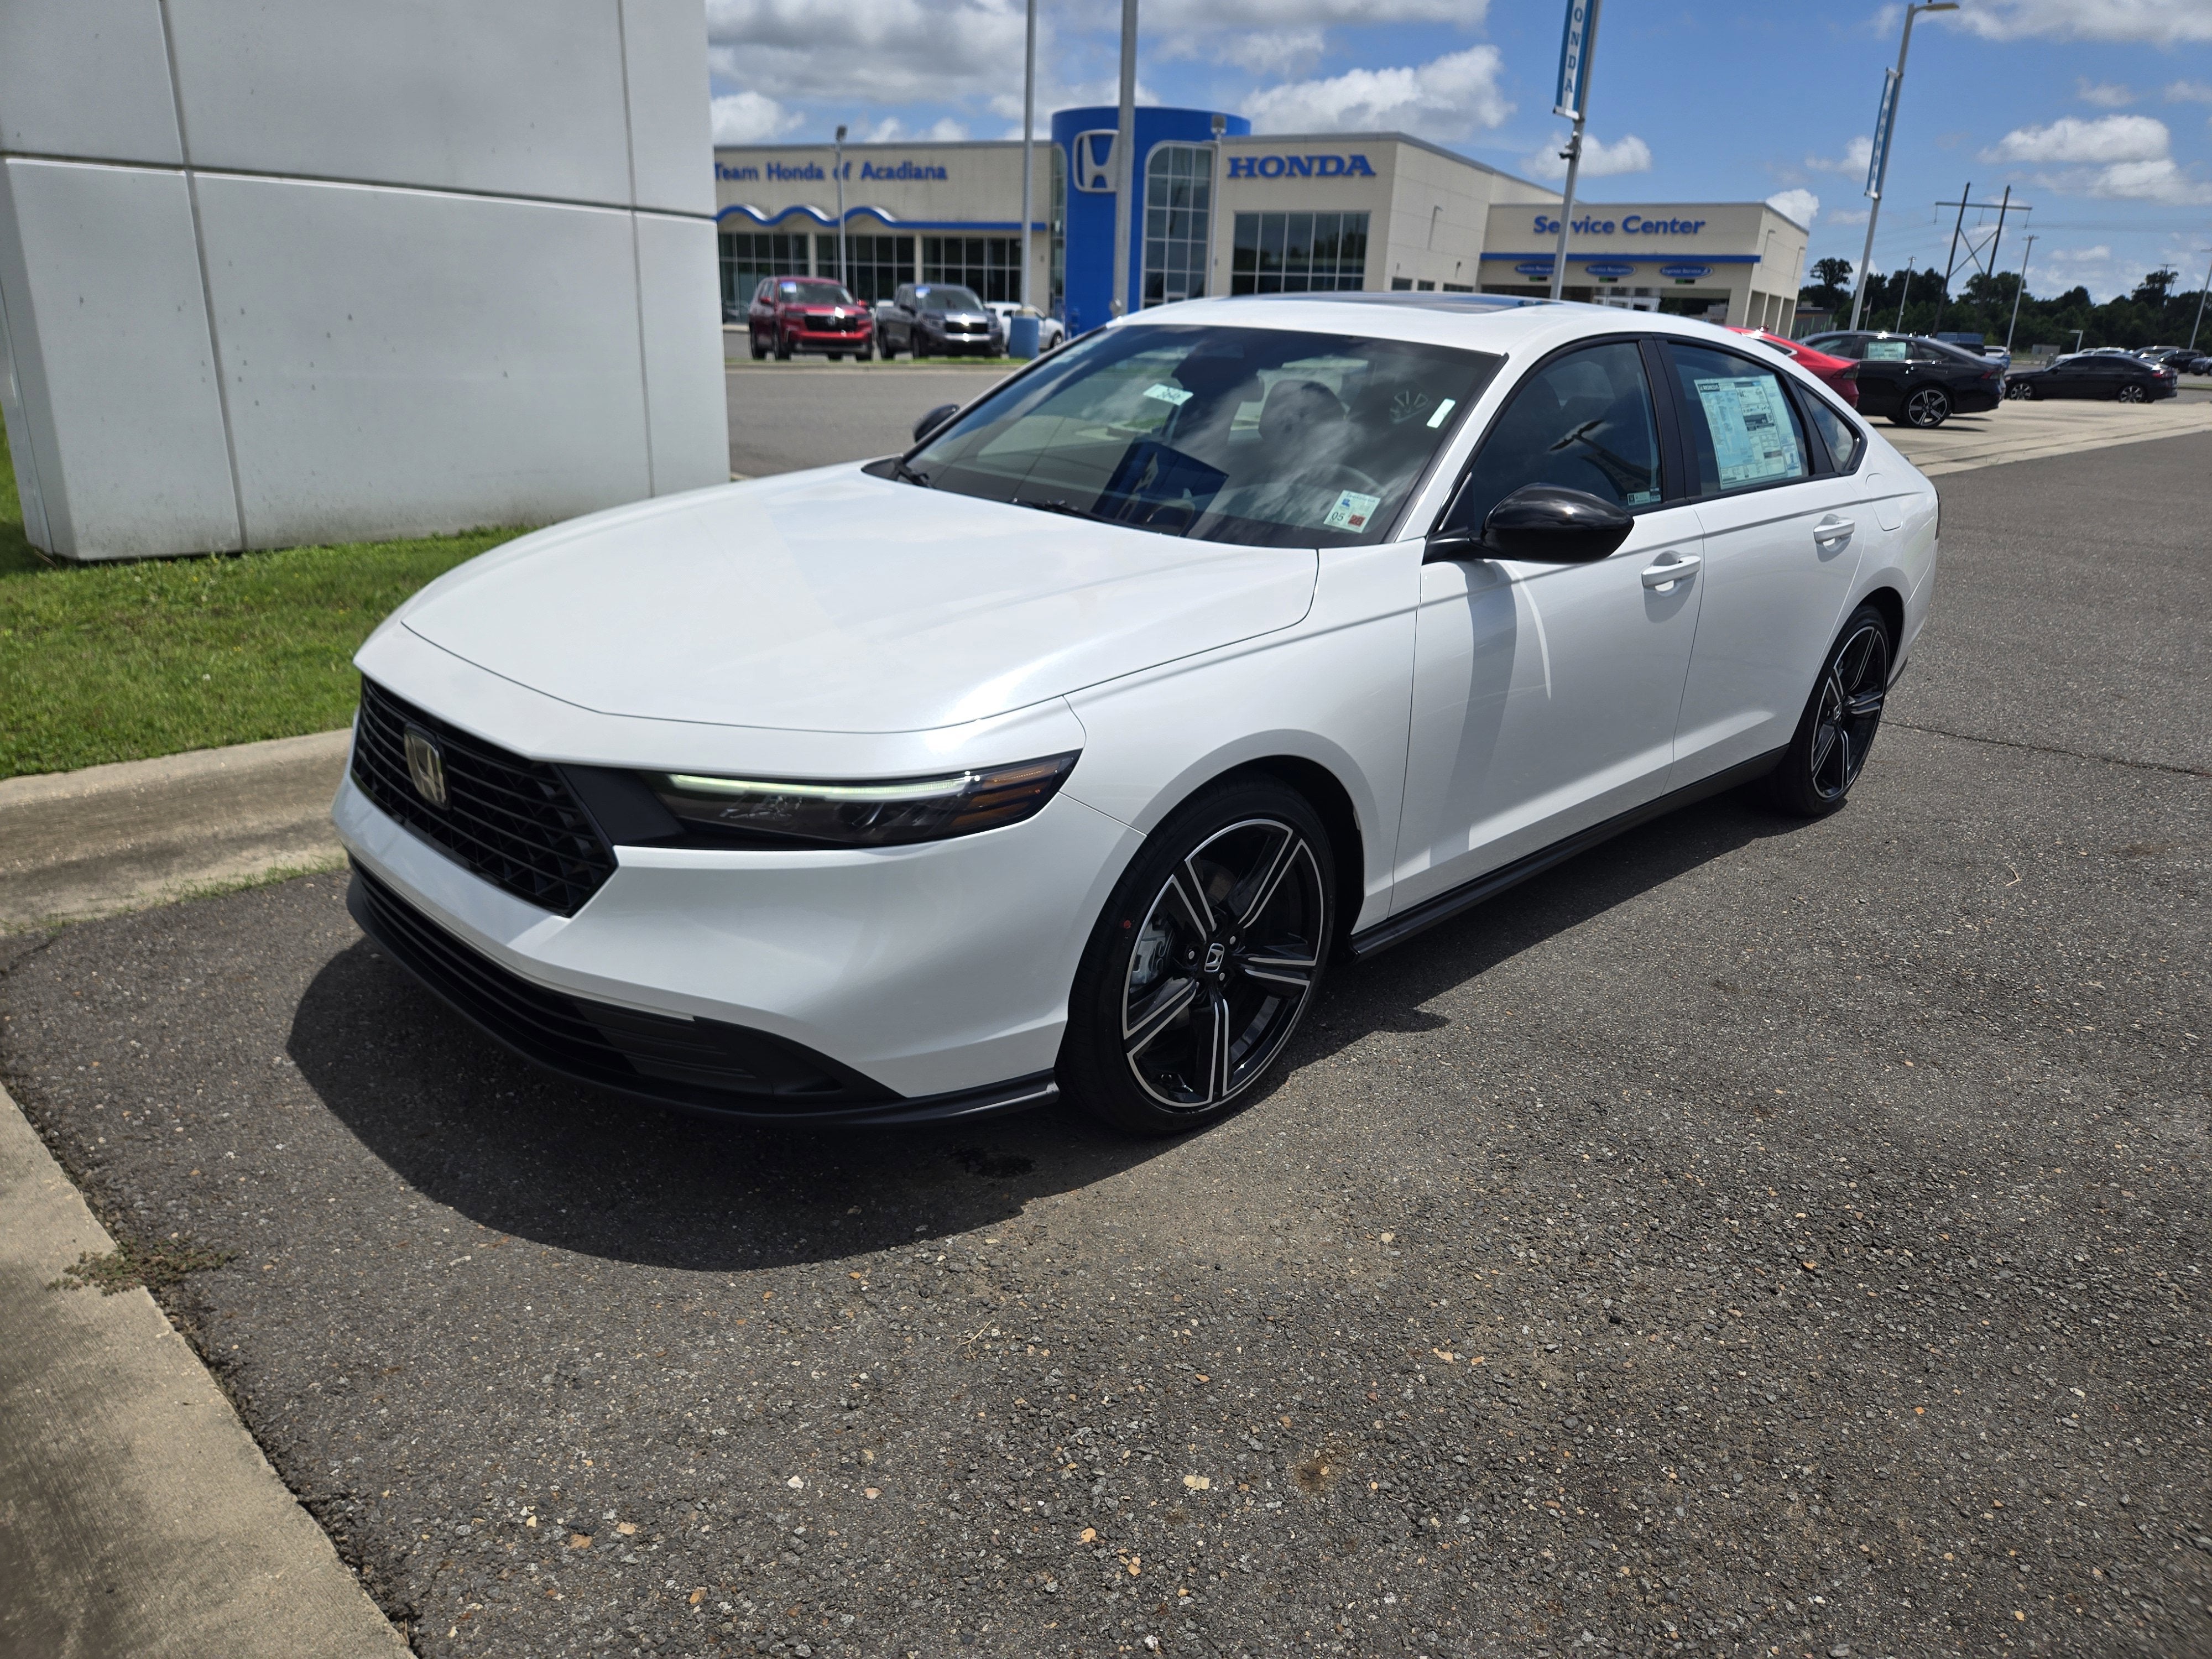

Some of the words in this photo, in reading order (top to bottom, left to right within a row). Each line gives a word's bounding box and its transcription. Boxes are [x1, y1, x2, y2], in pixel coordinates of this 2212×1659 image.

[715, 161, 759, 180] Team
[766, 160, 825, 180] Honda
[833, 161, 851, 180] of
[861, 160, 947, 180] Acadiana
[1227, 154, 1376, 178] HONDA
[1533, 215, 1615, 234] Sevice
[1622, 215, 1705, 234] Center
[1332, 512, 1345, 521] 05
